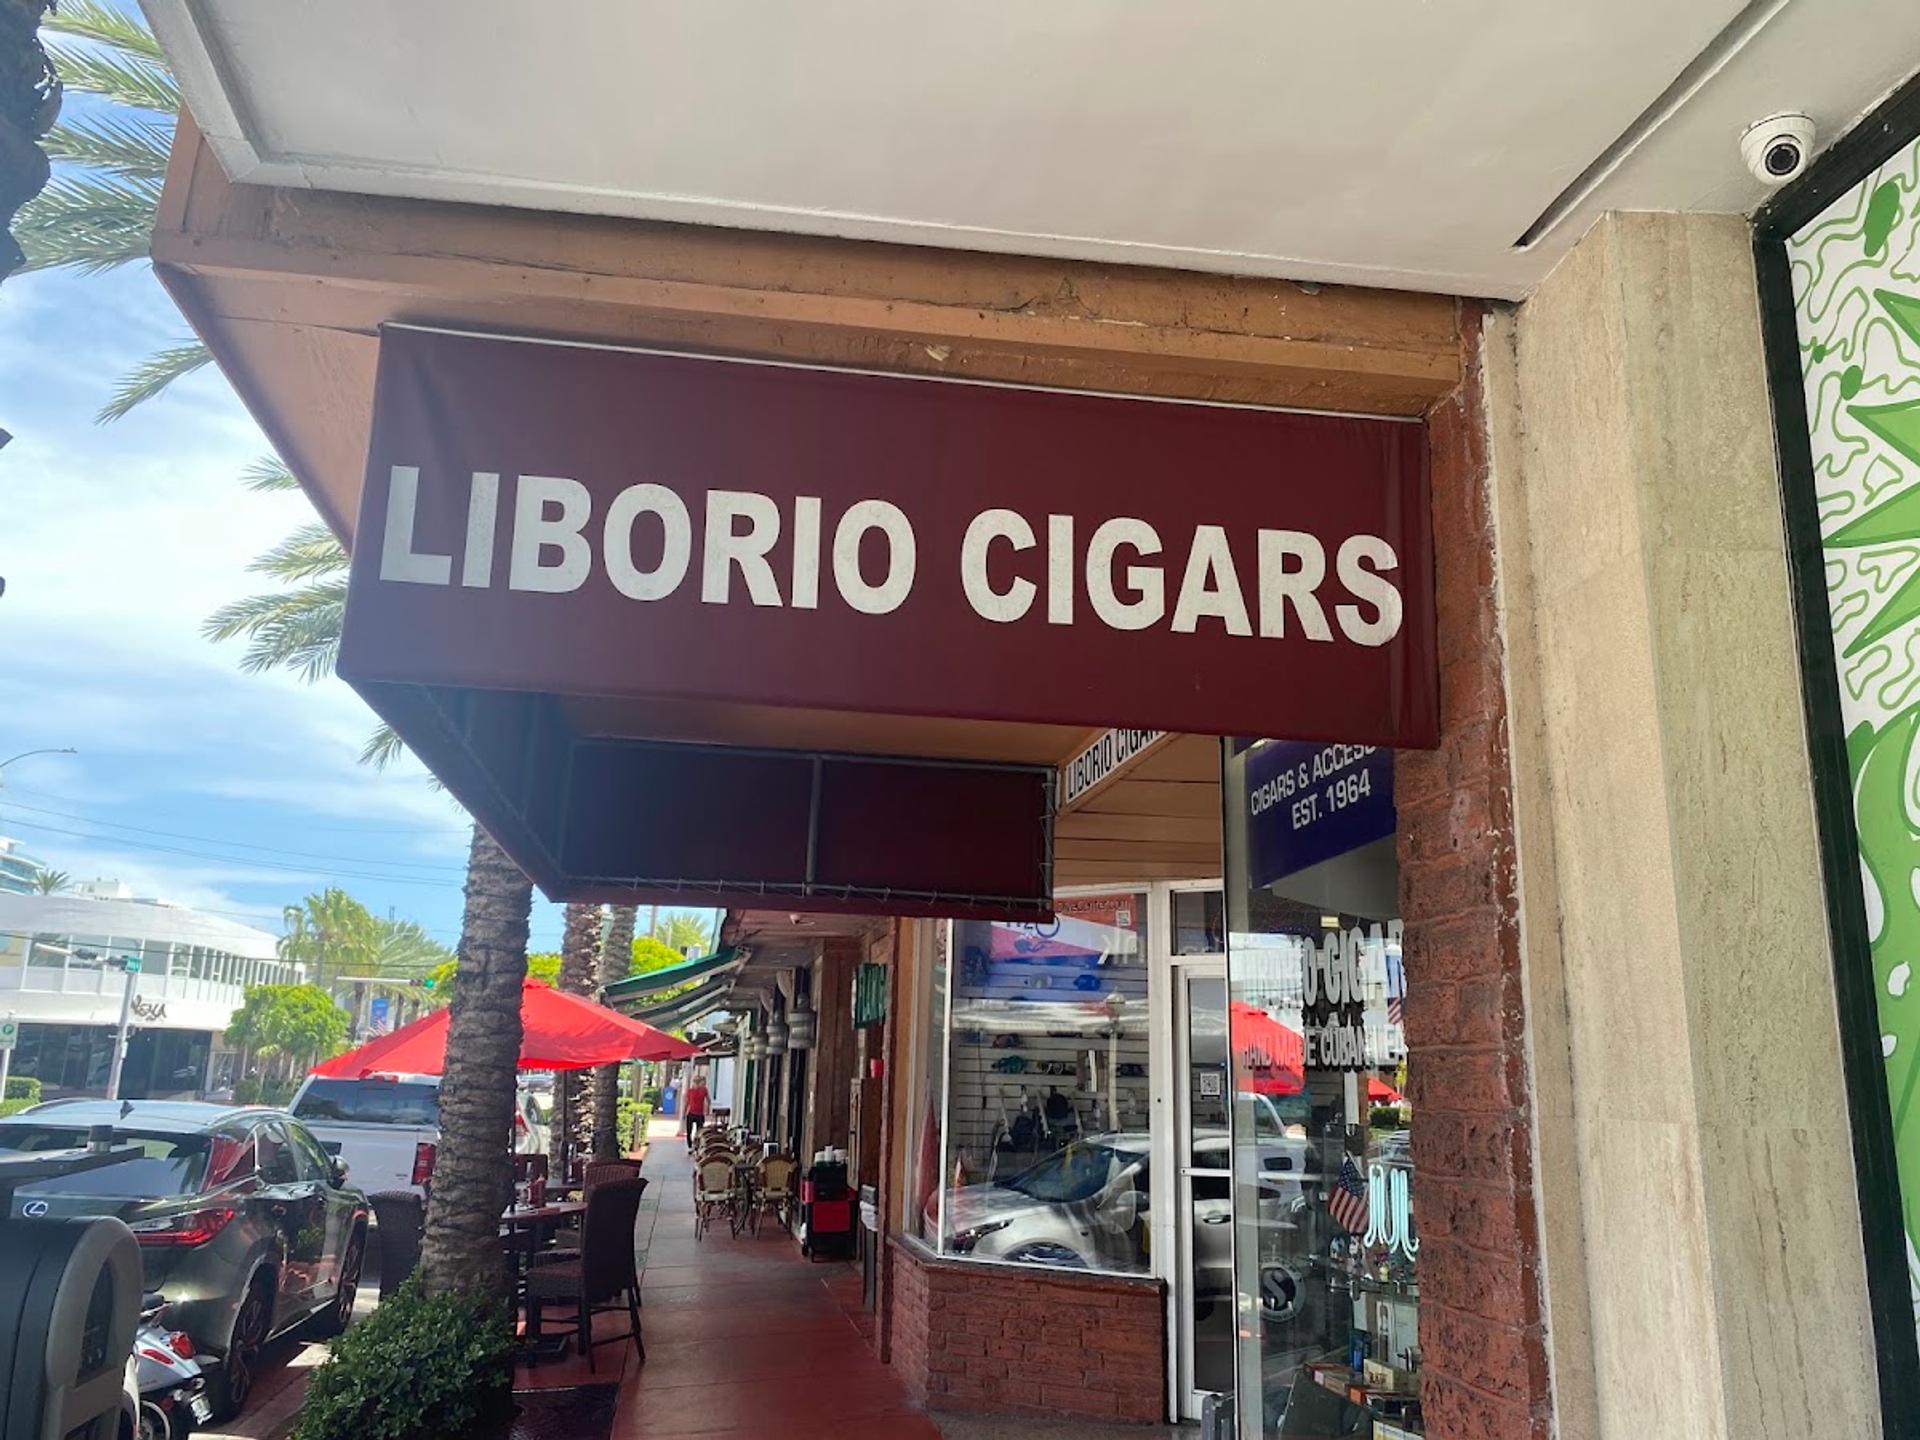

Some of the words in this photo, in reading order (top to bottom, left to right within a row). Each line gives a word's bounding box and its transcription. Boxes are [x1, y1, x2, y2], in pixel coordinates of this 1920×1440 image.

[379, 465, 917, 615] LIBORIO
[960, 508, 1402, 647] CIGARS
[1068, 733, 1112, 799] LIBORIO
[1250, 769, 1296, 816] CIGARS
[1298, 762, 1310, 789] &
[1291, 793, 1323, 831] EST.
[1326, 767, 1371, 813] 1964
